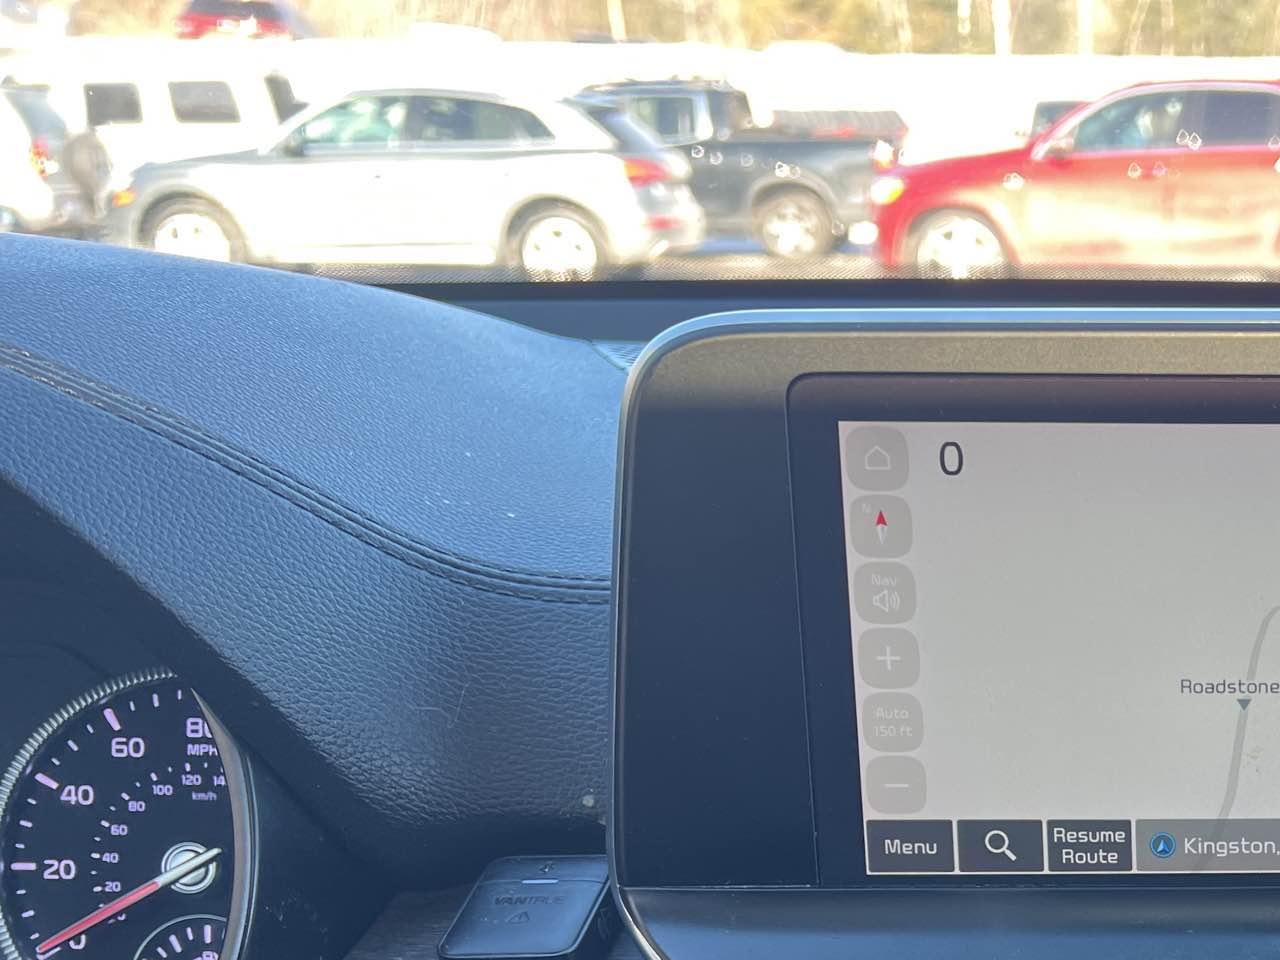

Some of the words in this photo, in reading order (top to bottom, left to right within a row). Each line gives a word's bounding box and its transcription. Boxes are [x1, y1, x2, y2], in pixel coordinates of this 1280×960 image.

[939, 441, 964, 476] 0
[871, 573, 897, 587] Nav
[1180, 679, 1280, 694] Roadstone
[876, 706, 909, 720] Auto
[874, 726, 897, 737] 150
[900, 725, 913, 737] ft
[111, 737, 145, 758] 60
[187, 744, 218, 756] MPH
[182, 774, 201, 786] 120
[213, 775, 226, 786] 14
[60, 785, 94, 805] 40
[152, 785, 173, 795] 100
[191, 791, 217, 801] km/h
[128, 801, 146, 812] 80
[110, 825, 128, 836] 60
[1053, 827, 1126, 843] Resume
[884, 838, 938, 855] Menu
[1184, 837, 1280, 857] Kingston,
[102, 853, 119, 863] 40
[1062, 849, 1119, 864] Route
[43, 859, 76, 880] 20
[104, 882, 121, 892] 20
